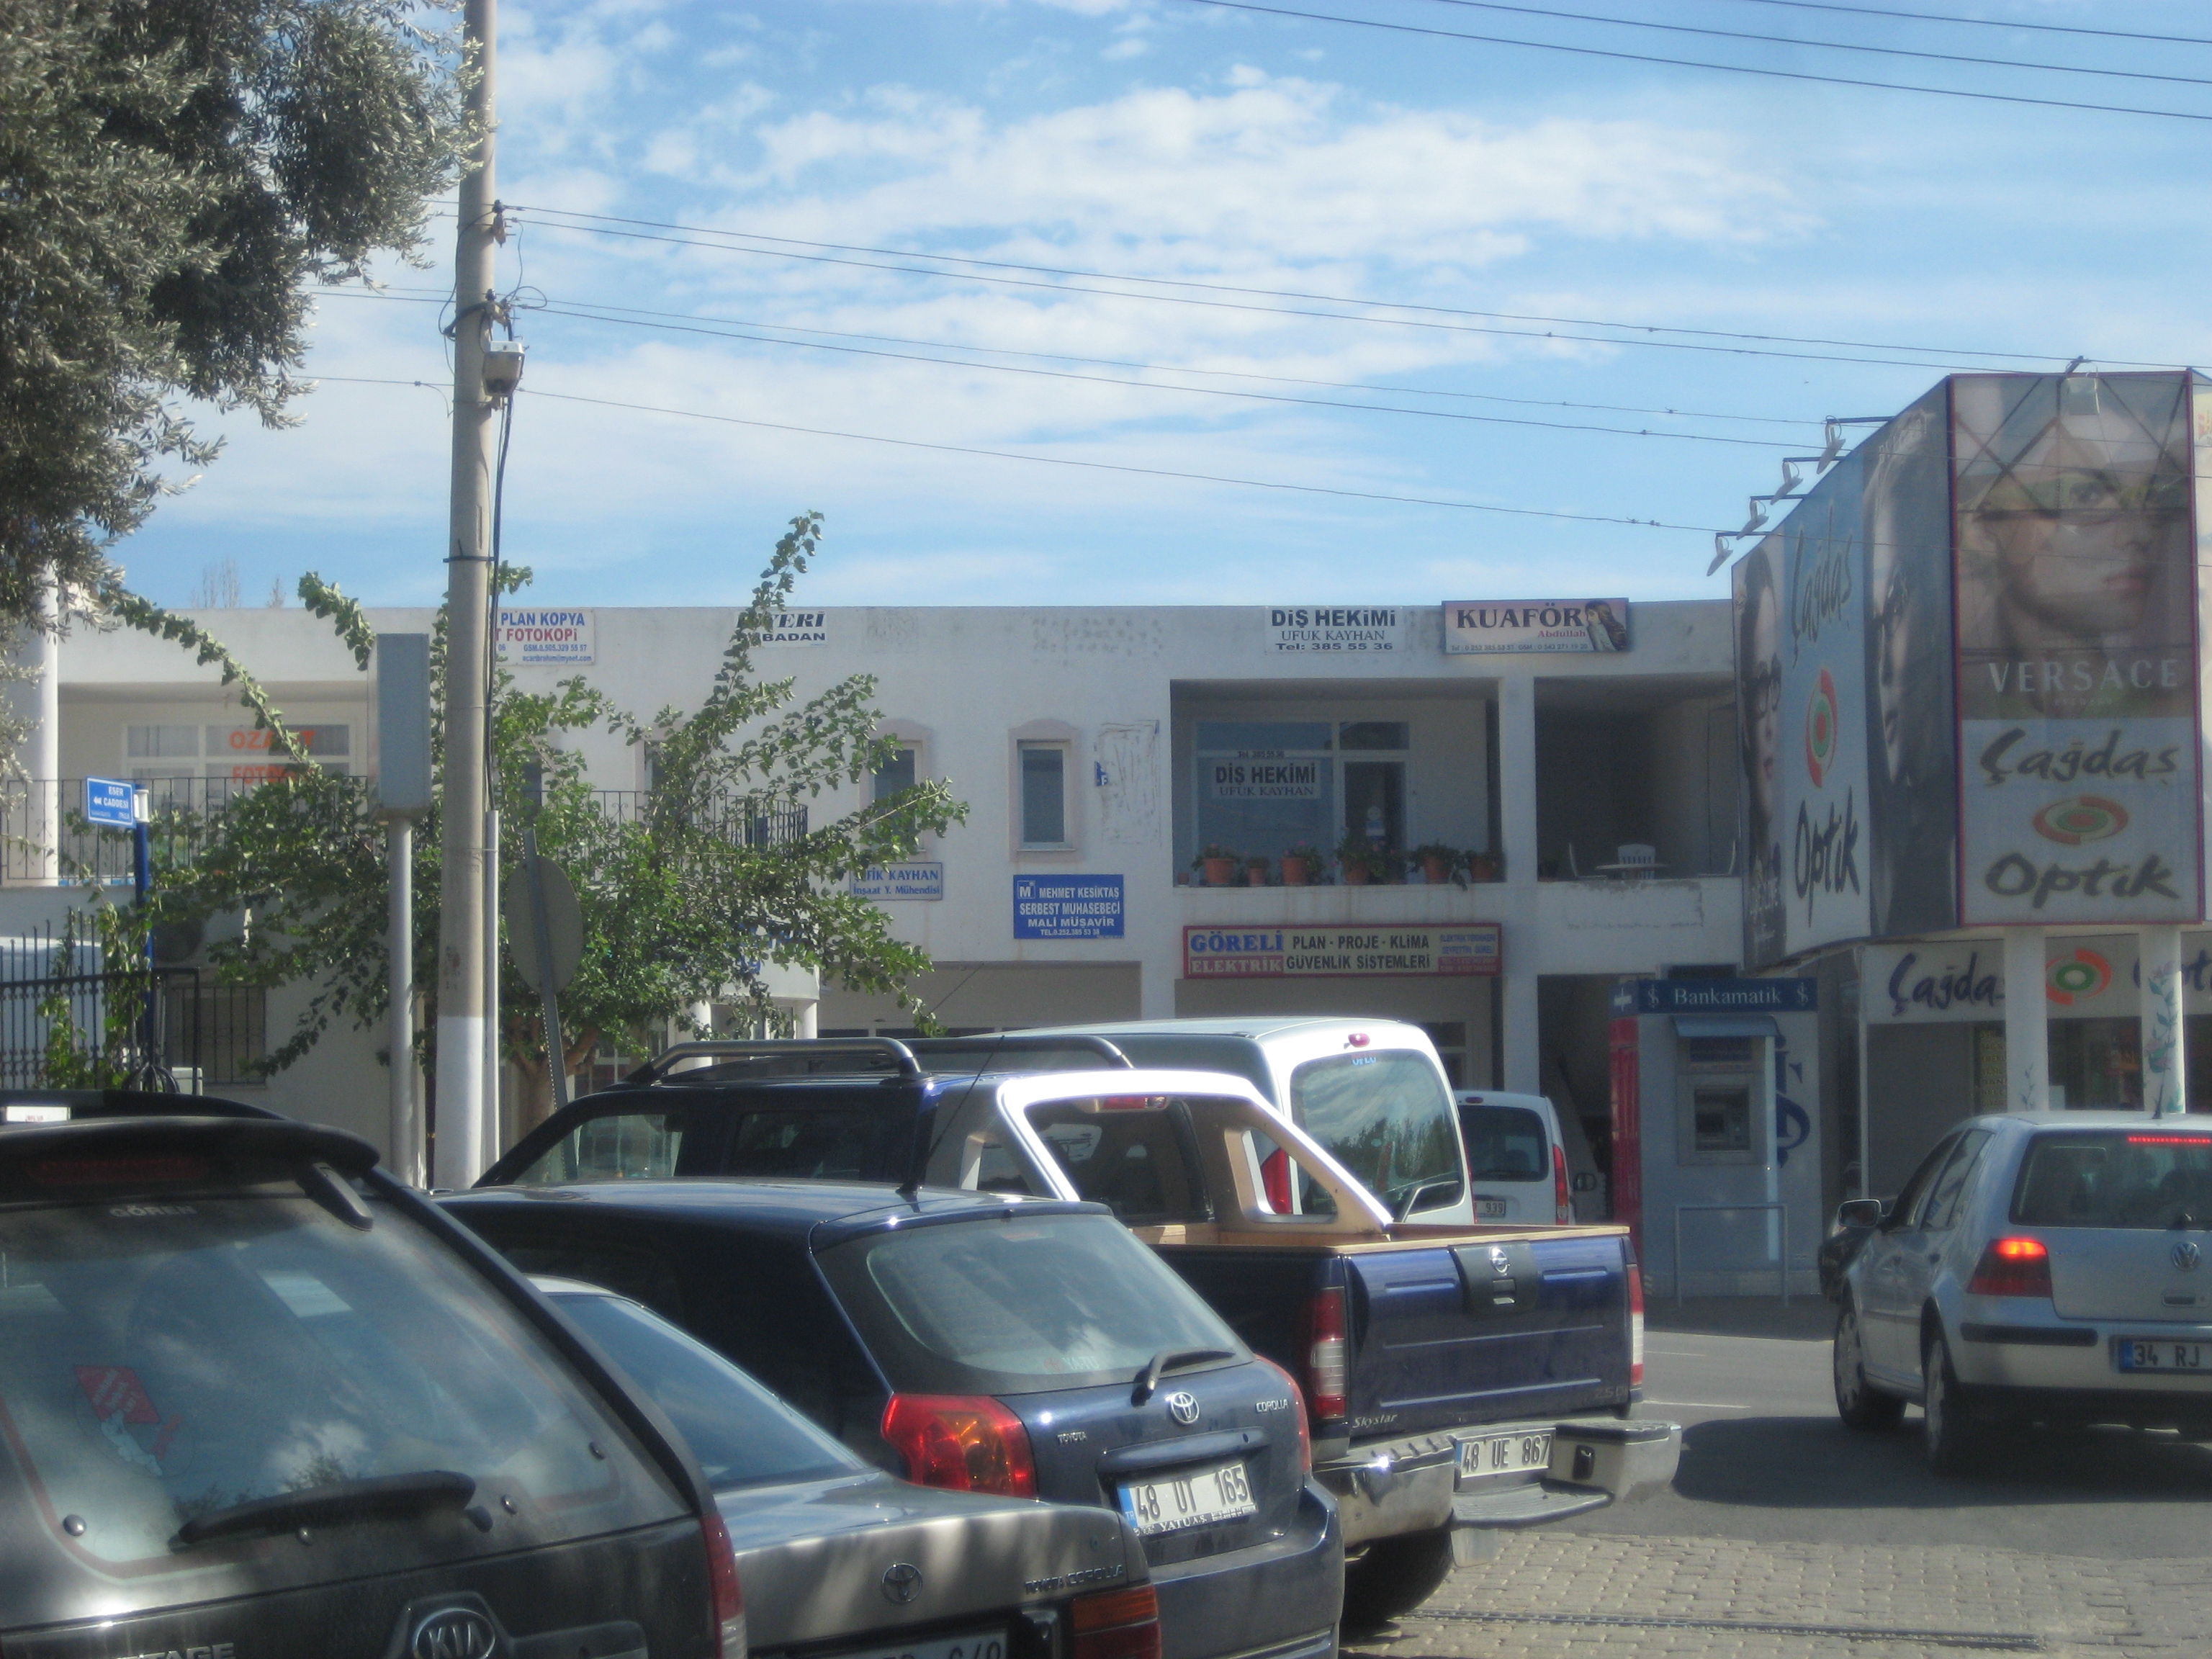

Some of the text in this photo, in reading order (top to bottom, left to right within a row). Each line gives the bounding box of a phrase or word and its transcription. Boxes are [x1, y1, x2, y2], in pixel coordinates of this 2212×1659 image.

[501, 612, 585, 626] PLAN KOPYA
[1457, 602, 1585, 628] KUAFÖR
[1281, 630, 1385, 641] UFUK KAYHAN
[1537, 629, 1586, 638] Abdullah
[1988, 658, 2179, 693] VERSACE
[1979, 727, 2180, 788] Çağdaş
[1251, 763, 1316, 783] HEKİMİ
[108, 786, 124, 796] ESER
[1220, 786, 1314, 796] UFUK KAYHAN
[889, 870, 939, 881] KAYHAN
[853, 884, 881, 895] İnşaat
[895, 885, 940, 895] Mühendisi
[1039, 887, 1076, 899] MEHMET
[1020, 901, 1120, 915] SERBEST MUHASEBECİ
[1028, 916, 1115, 929] MALİ MÜŞAVİR
[1190, 930, 1285, 953] GÖRELİ
[1292, 935, 1326, 950] PLAN
[1338, 935, 1380, 949] PROJE
[1390, 935, 1430, 949] KLİMA
[1191, 957, 1283, 973] ELEKTRİK
[1286, 955, 1352, 970] GÜVENLİK
[1357, 953, 1430, 969] SİSTEMLERİ
[1887, 951, 2007, 1017] Çağda
[1674, 987, 1782, 1005] Bankamatik
[2134, 1344, 2159, 1367] 34
[1256, 1398, 1289, 1413] COROLLA
[1352, 1413, 1399, 1429] Skystar
[1057, 1431, 1088, 1444] TOYOTA
[1462, 1434, 1551, 1473] 48 UE 867
[1136, 1484, 1161, 1523] 48
[1173, 1478, 1197, 1515] UT
[1213, 1466, 1248, 1507] 165
[1159, 1517, 1192, 1532] YATU
[1025, 1564, 1123, 1595] TOYOTA COROLLA
[428, 1622, 488, 1659] KIA
